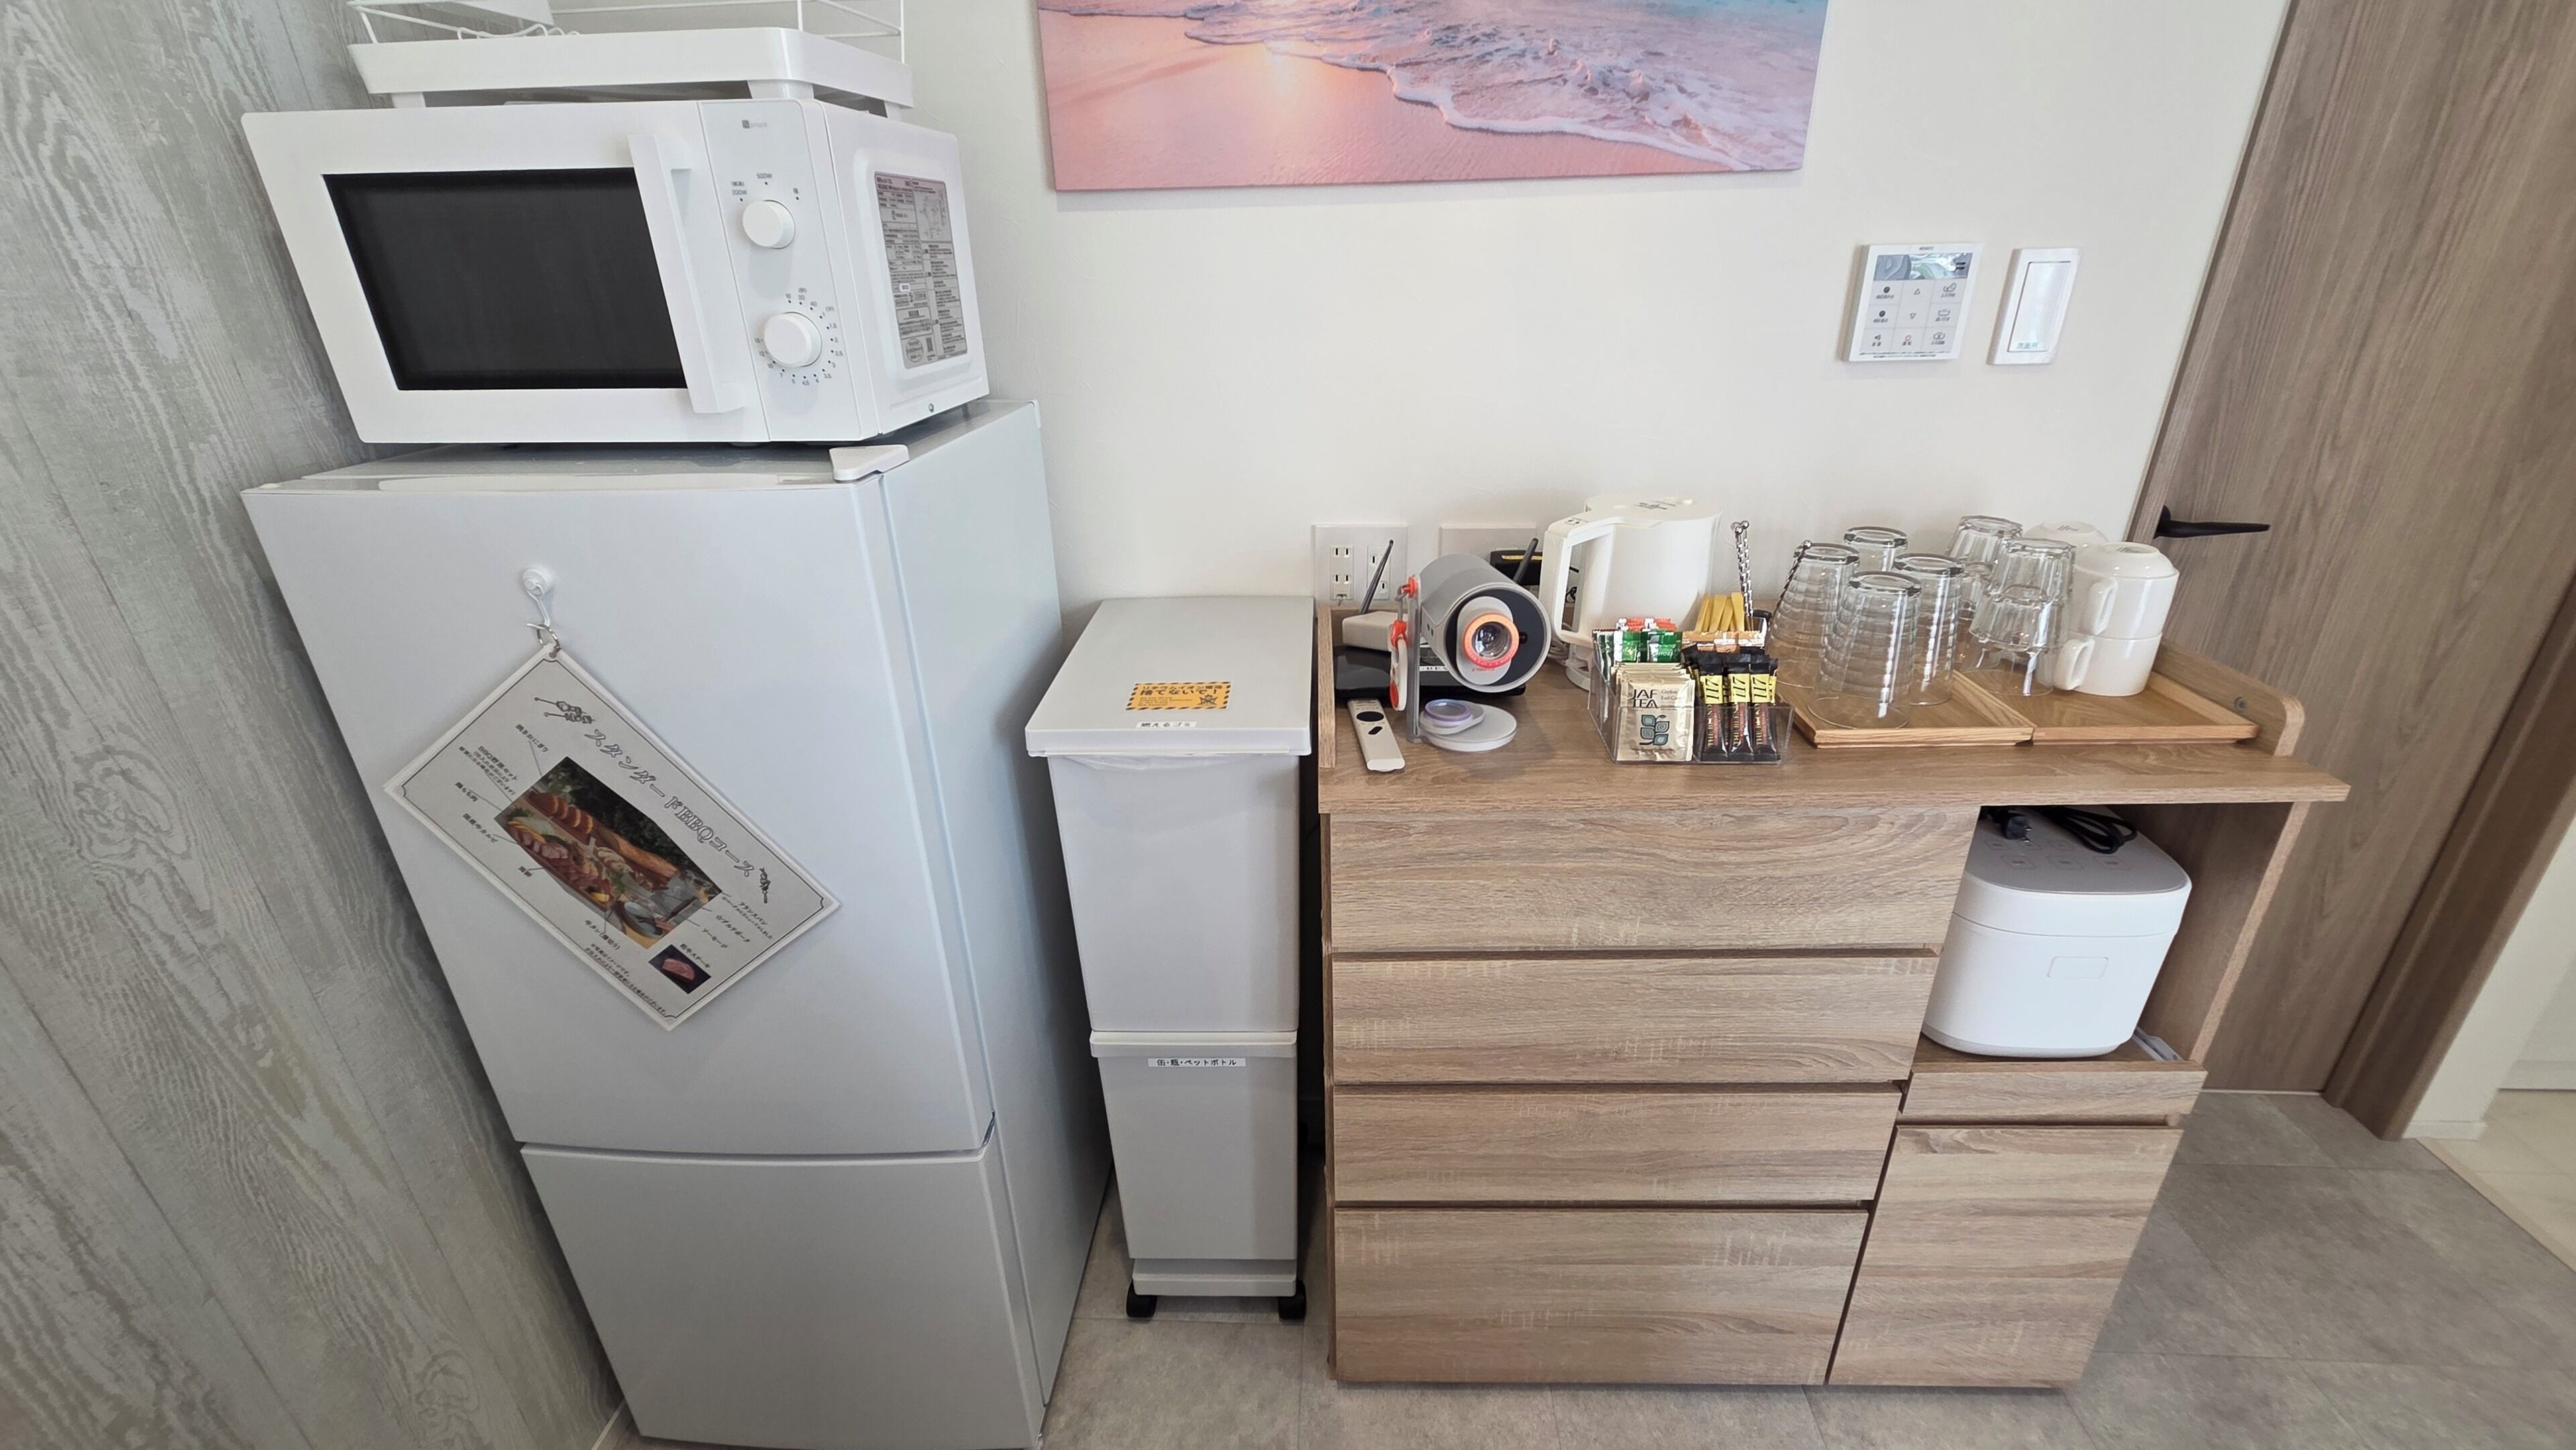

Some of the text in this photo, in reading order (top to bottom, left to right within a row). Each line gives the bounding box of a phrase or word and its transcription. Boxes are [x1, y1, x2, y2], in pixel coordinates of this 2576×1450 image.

[1631, 689, 1658, 699] JAF
[1705, 678, 1719, 701] 117
[1733, 676, 1746, 698] 117
[1753, 676, 1767, 698] 117
[1633, 698, 1658, 709] TEA
[514, 723, 549, 753] 焼きおにぎり
[477, 745, 517, 780] BBQ野菜セット
[584, 729, 754, 877] スタンダードBBQコース
[462, 812, 498, 843] 国産牛カルビ
[737, 900, 768, 925] フランスパン
[700, 927, 729, 949] ソーセージ
[679, 942, 710, 968] 和牛ステーキ
[1157, 1058, 1237, 1067] 缶・瓶・ペットボトル
